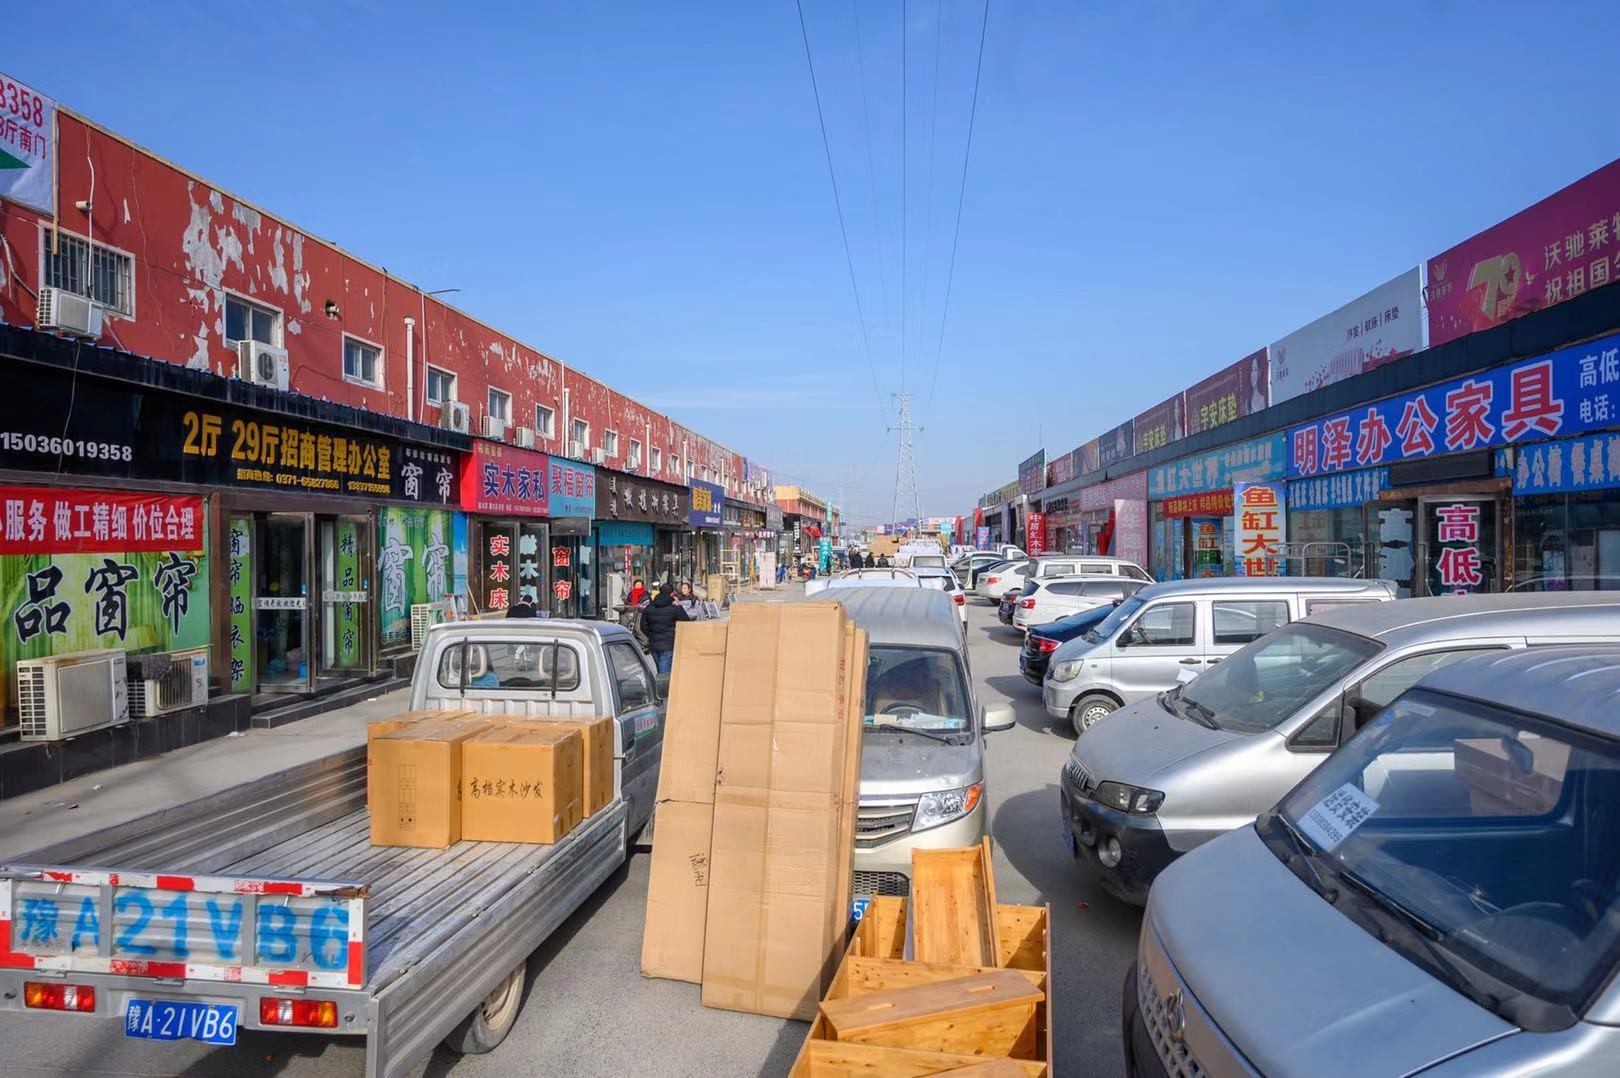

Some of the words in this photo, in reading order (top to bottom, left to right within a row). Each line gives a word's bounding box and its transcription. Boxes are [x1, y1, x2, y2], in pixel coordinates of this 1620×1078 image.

[183, 411, 222, 457] 2厅
[231, 418, 391, 481] 29厅招商管理办公室
[1293, 359, 1565, 476] 明泽办公家具
[0, 432, 133, 462] 15036019358
[1155, 456, 1219, 493] 鱼缸大世界
[401, 461, 453, 505] 窗帘
[483, 460, 546, 502] 实木家私
[0, 499, 47, 542] 服务
[53, 500, 128, 541] 做工精细
[132, 502, 195, 541] 价位合理
[377, 532, 450, 617] 窗帘
[489, 534, 511, 610] 实木床
[552, 545, 572, 602] 窗帘
[1436, 504, 1482, 596] 高低
[15, 552, 198, 644] 品窗帘
[470, 776, 544, 801] 高档实木沙发
